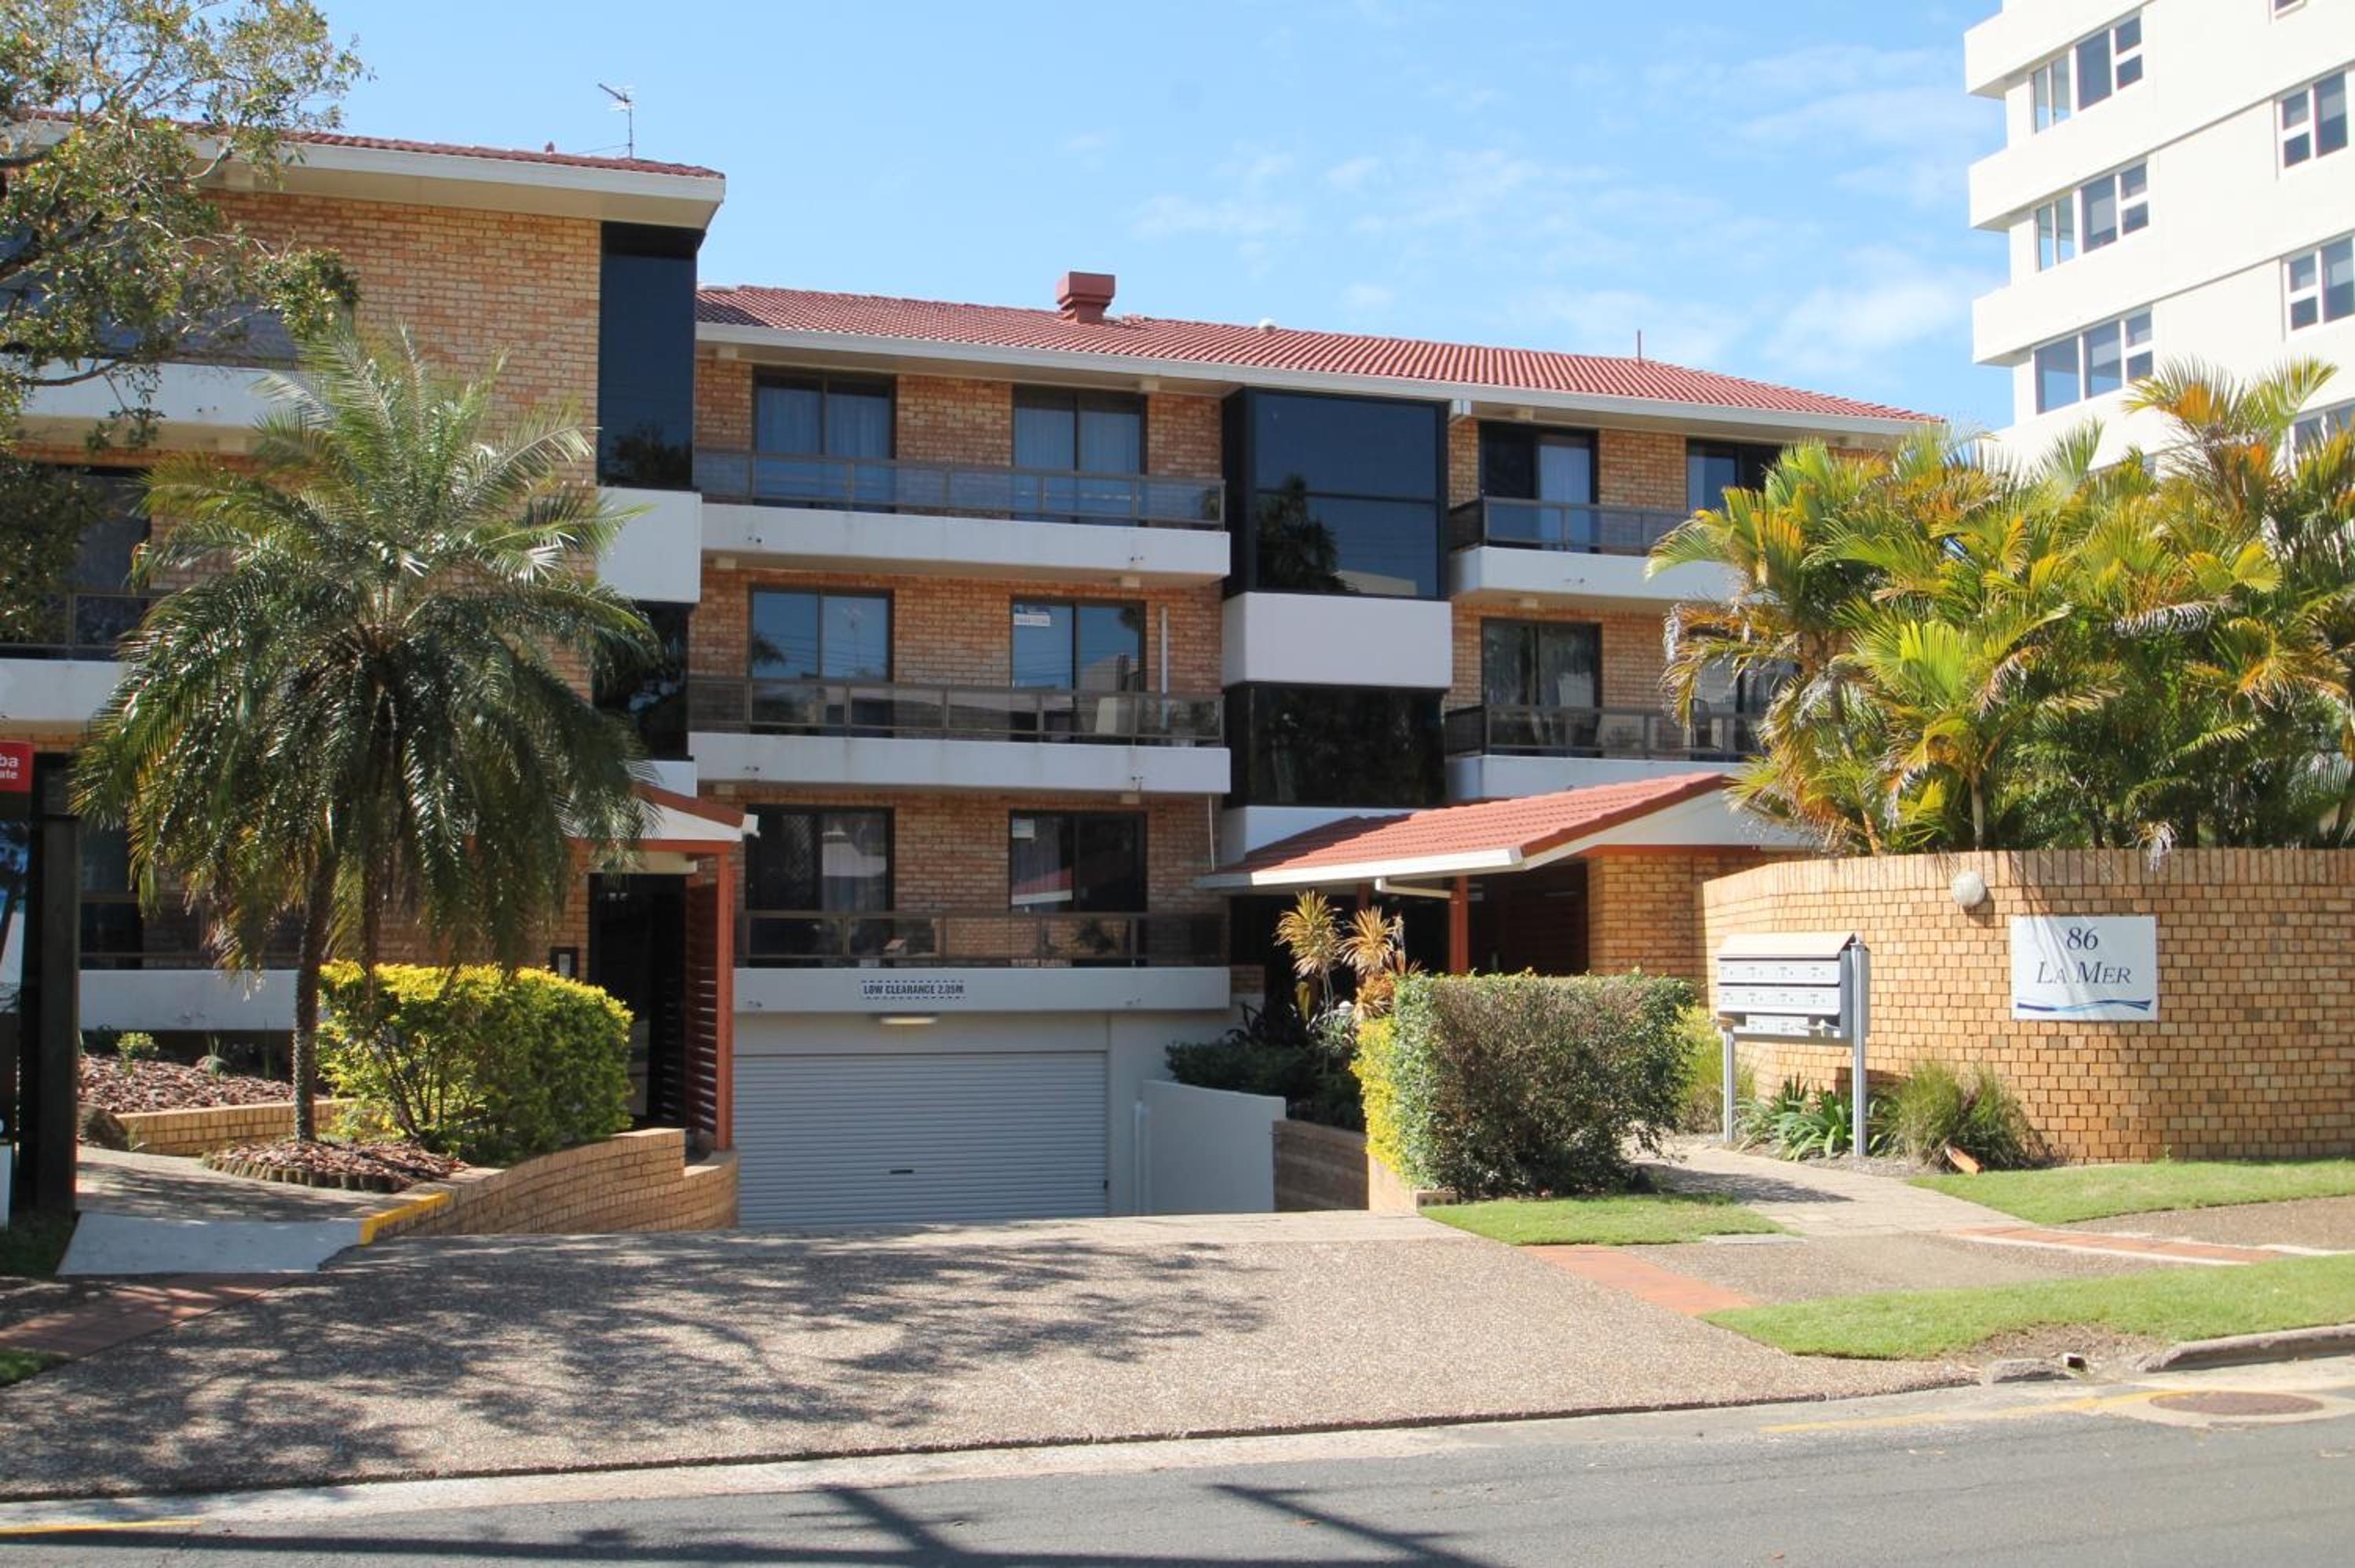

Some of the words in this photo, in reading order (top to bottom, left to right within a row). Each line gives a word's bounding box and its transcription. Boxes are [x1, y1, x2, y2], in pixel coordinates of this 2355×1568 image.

[2066, 927, 2099, 950] 86
[2036, 961, 2067, 984] LA
[2076, 961, 2133, 984] MER
[864, 985, 883, 994] LOW
[885, 985, 935, 994] CLEARANCE
